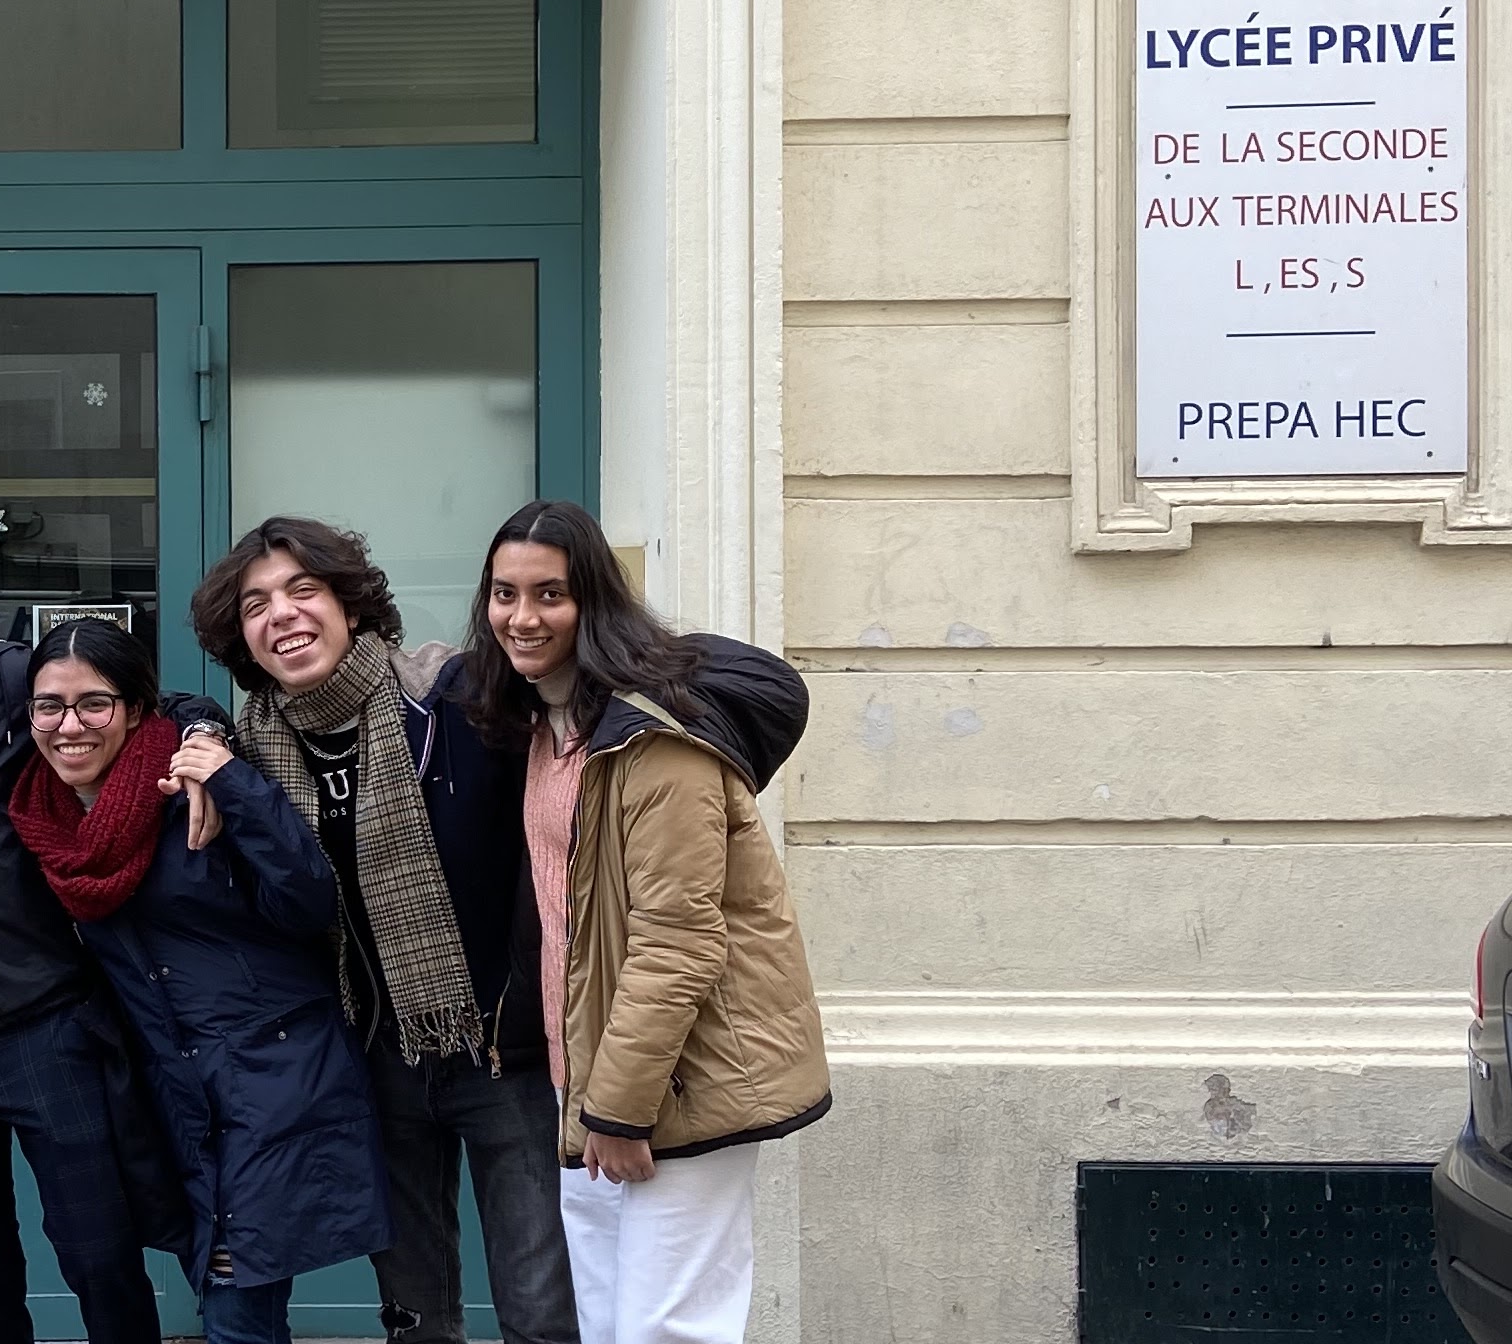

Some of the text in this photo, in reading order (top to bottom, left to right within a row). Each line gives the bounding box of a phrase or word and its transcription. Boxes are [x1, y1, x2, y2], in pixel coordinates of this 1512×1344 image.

[1146, 6, 1456, 69] LYCÉE PRIVÉ
[1153, 127, 1449, 165] DE LA SECONDE
[1144, 190, 1459, 229] AUX TERMINALES
[1179, 399, 1427, 440] PREPA HEC
